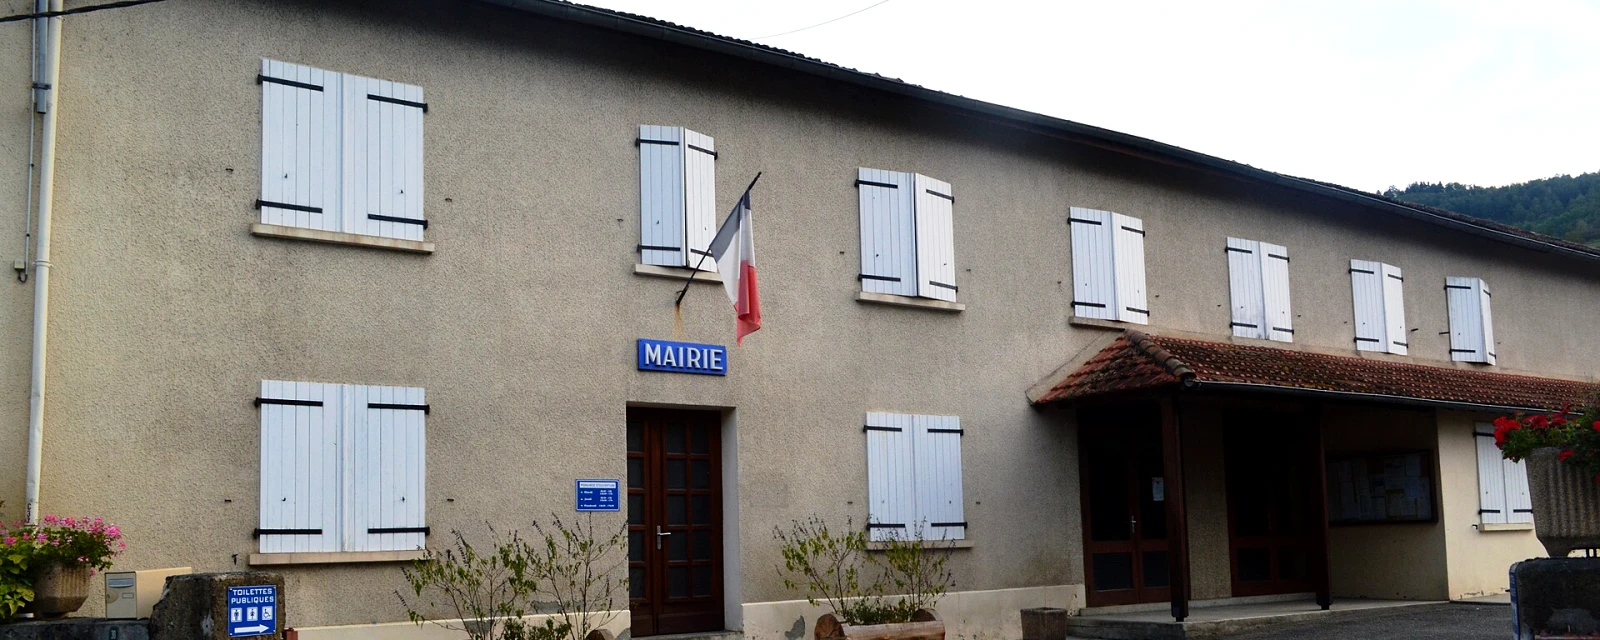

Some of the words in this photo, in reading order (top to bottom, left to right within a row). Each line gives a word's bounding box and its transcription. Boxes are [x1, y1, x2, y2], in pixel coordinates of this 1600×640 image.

[644, 343, 724, 370] MAIRIE
[232, 588, 273, 596] TOILETTES
[231, 595, 274, 604] PUBLIQUES
